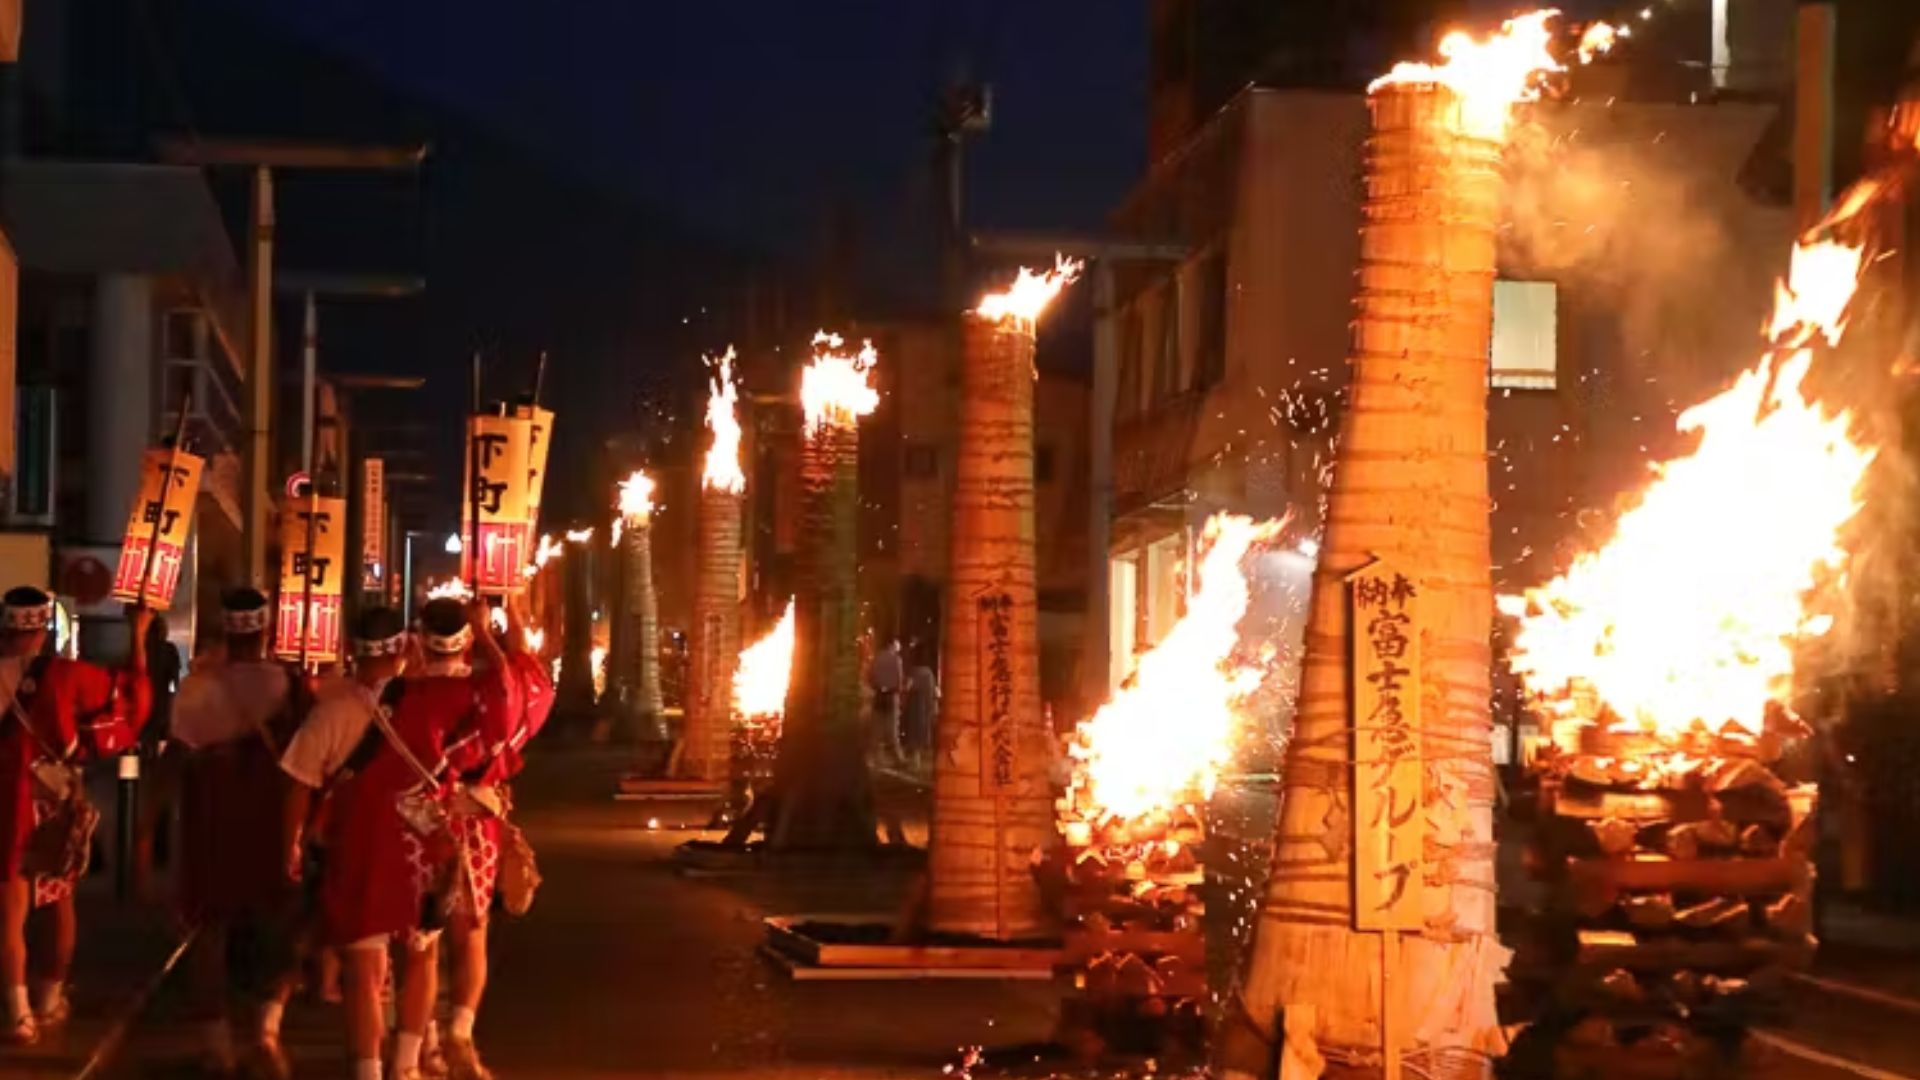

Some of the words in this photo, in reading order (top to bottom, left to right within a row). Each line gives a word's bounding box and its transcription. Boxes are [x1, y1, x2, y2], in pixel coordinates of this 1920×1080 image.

[143, 463, 190, 536] 下町
[471, 432, 508, 515] 下町
[293, 511, 331, 587] 下町
[1366, 609, 1418, 912] 富士急グループ
